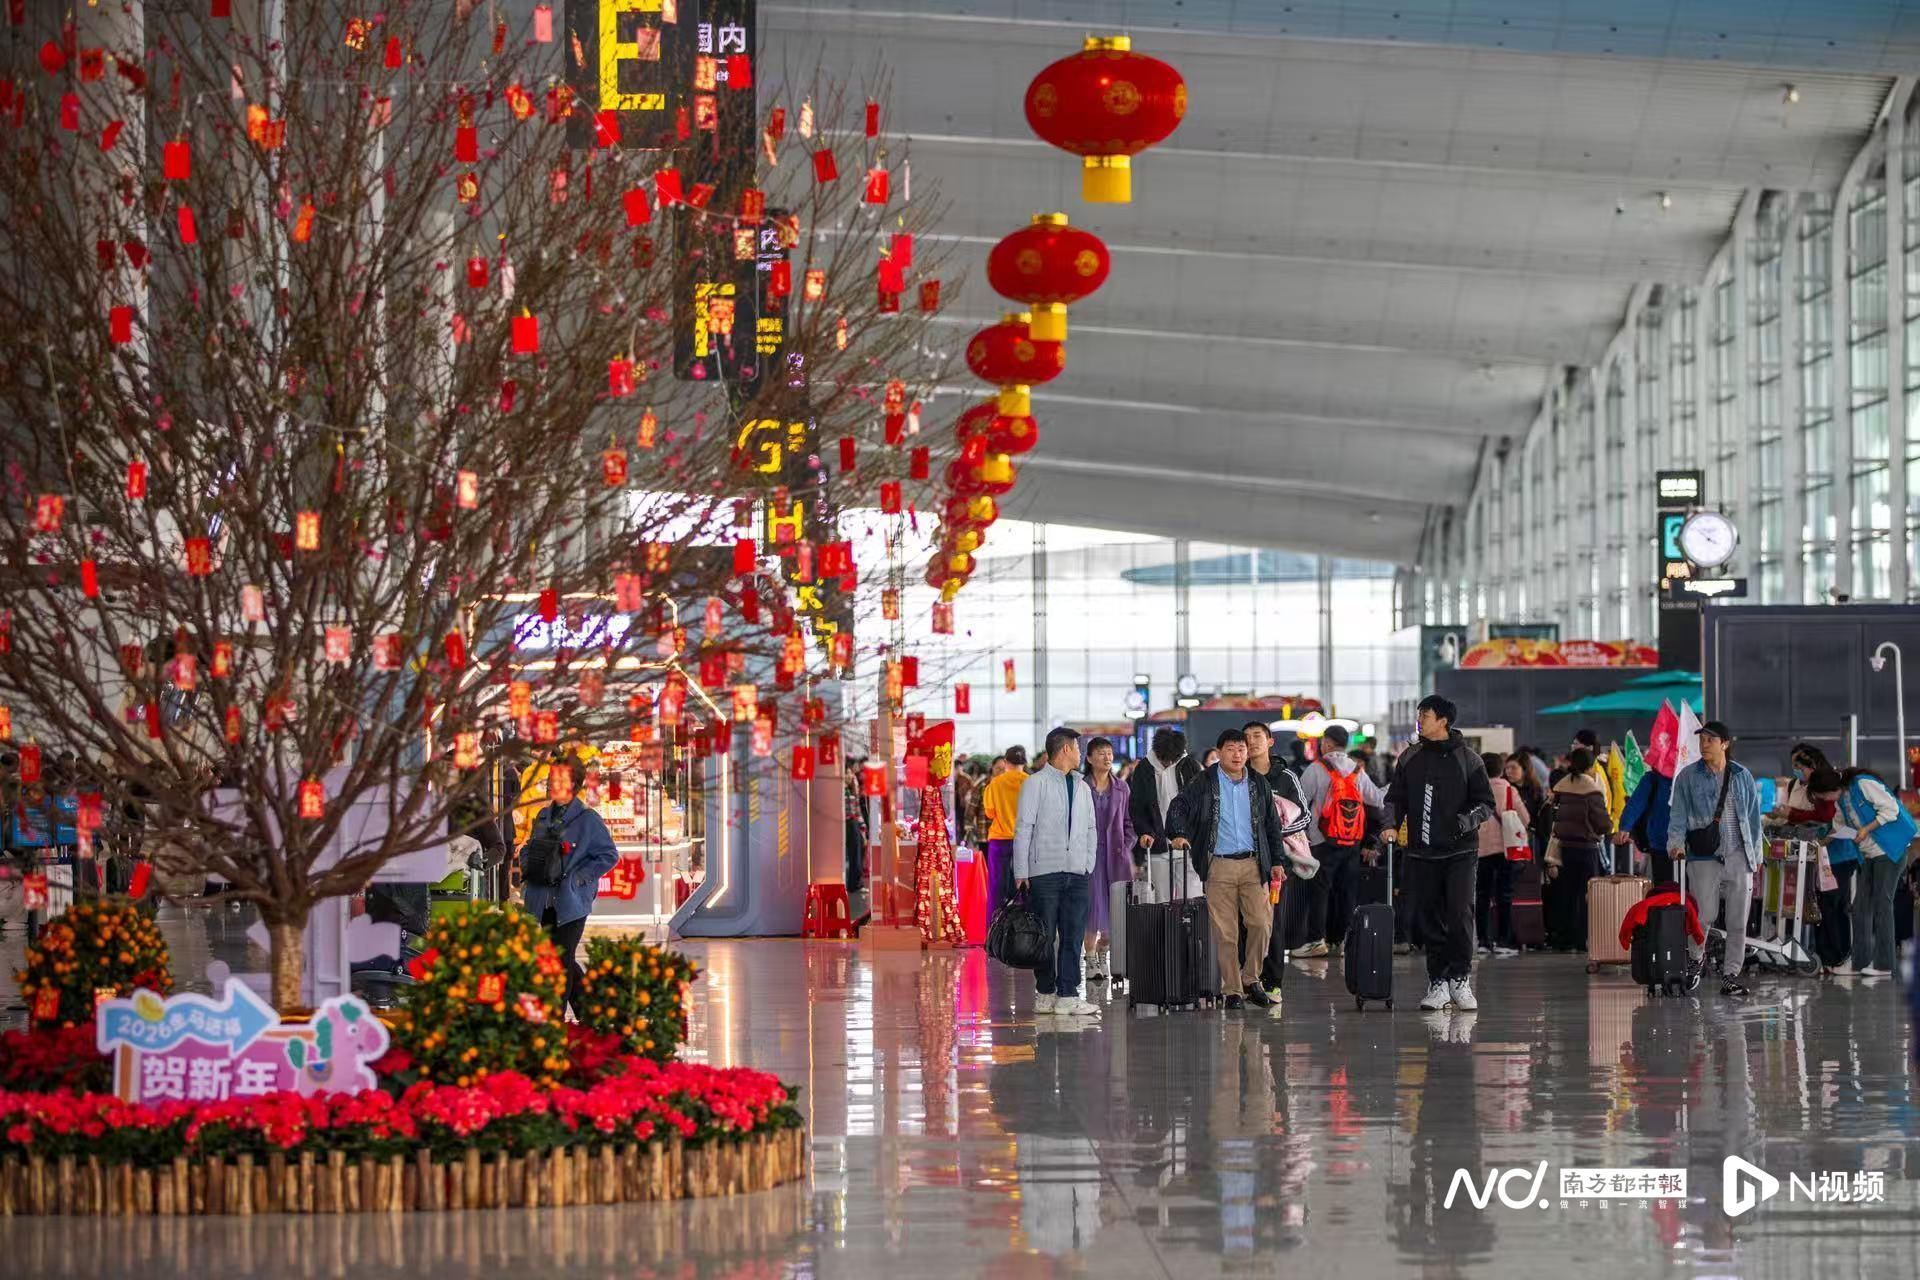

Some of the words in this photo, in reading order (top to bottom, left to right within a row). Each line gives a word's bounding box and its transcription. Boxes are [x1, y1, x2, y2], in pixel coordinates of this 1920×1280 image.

[599, 0, 665, 110] E
[695, 282, 736, 357] F
[738, 419, 782, 474] G
[768, 499, 803, 543] H
[142, 1055, 278, 1101] 贺新年
